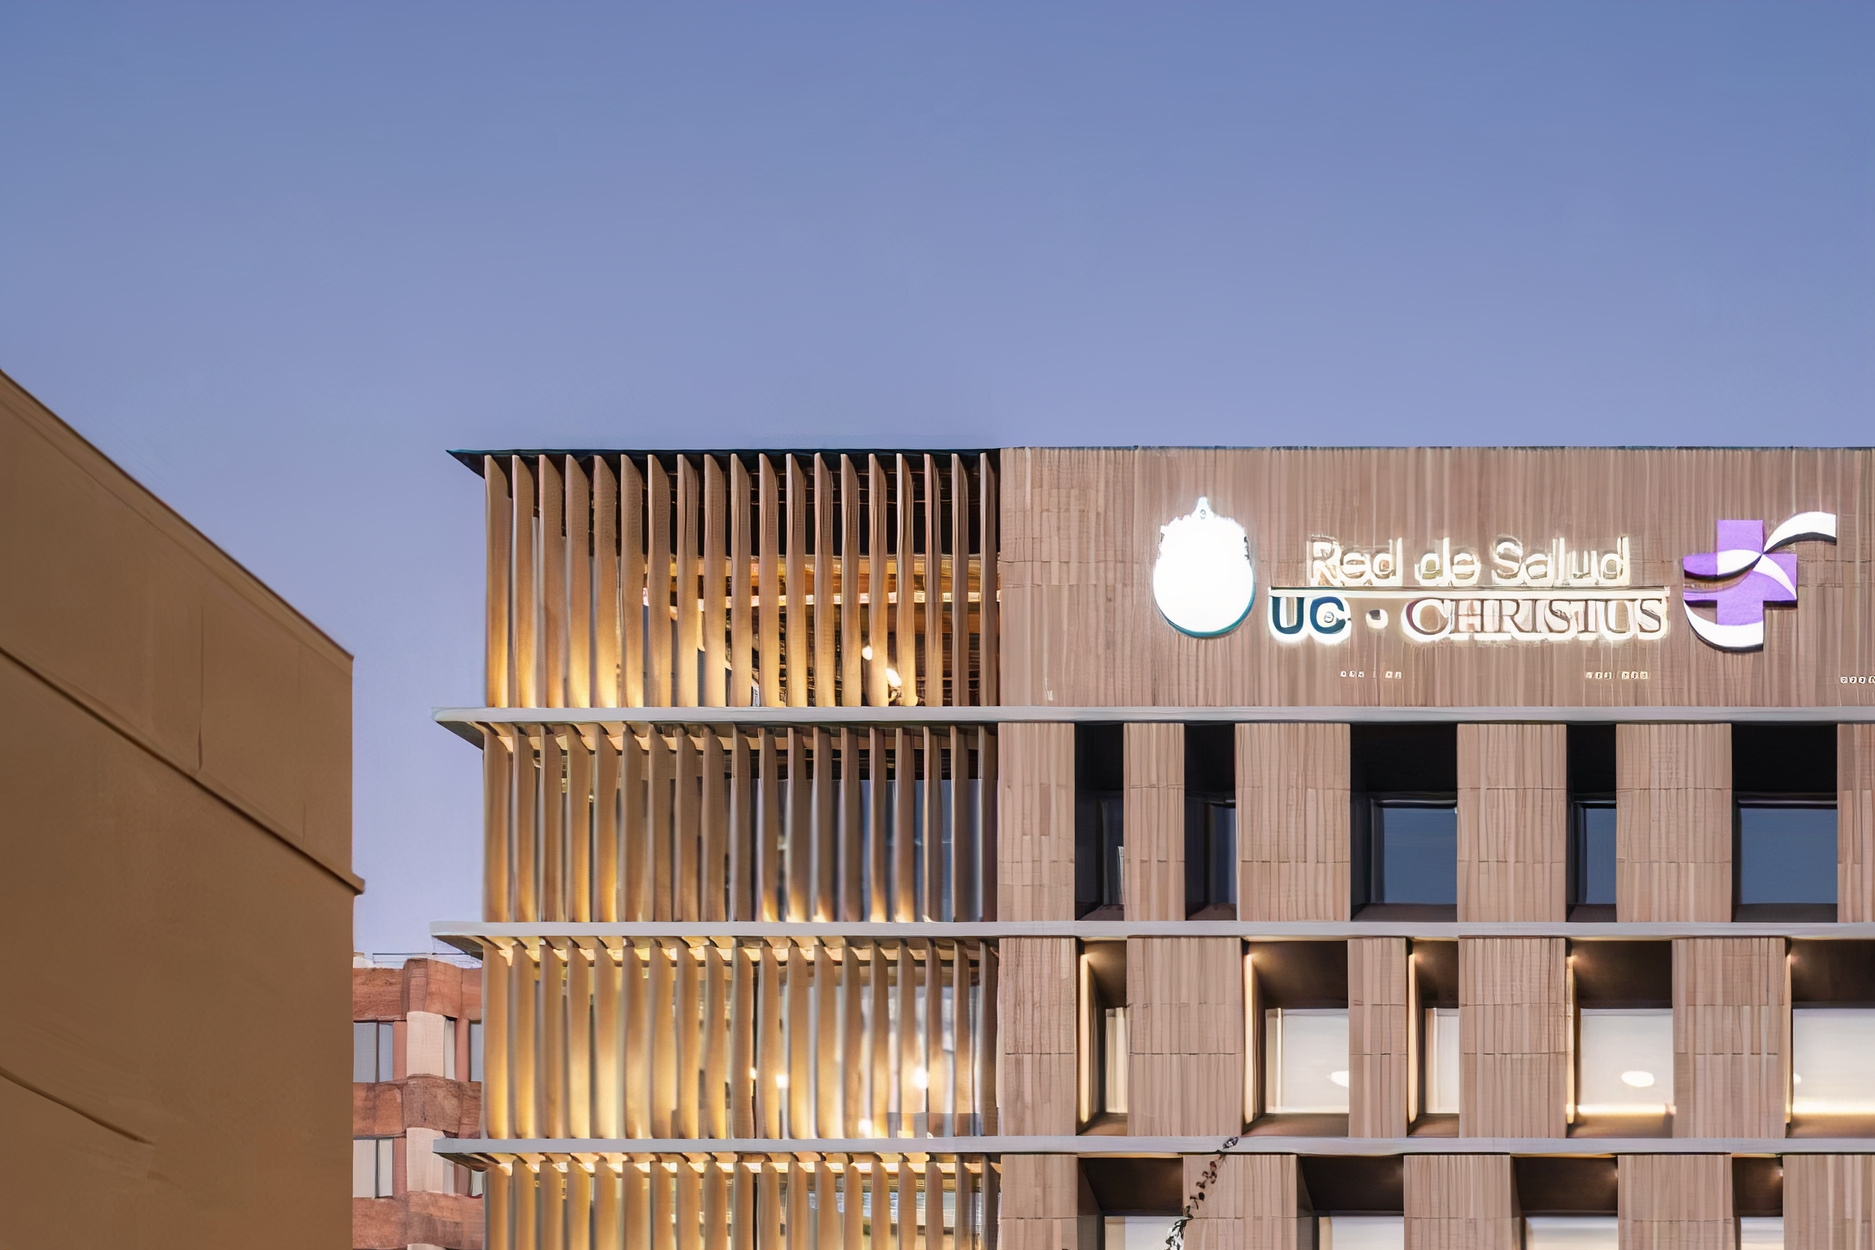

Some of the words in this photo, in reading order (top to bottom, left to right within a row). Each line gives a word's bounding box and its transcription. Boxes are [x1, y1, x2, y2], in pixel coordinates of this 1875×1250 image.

[1307, 536, 1404, 586] Red
[1415, 537, 1480, 586] de
[1491, 536, 1630, 586] Salud
[1270, 596, 1349, 639] UC
[1403, 598, 1668, 639] CHRISTUS
